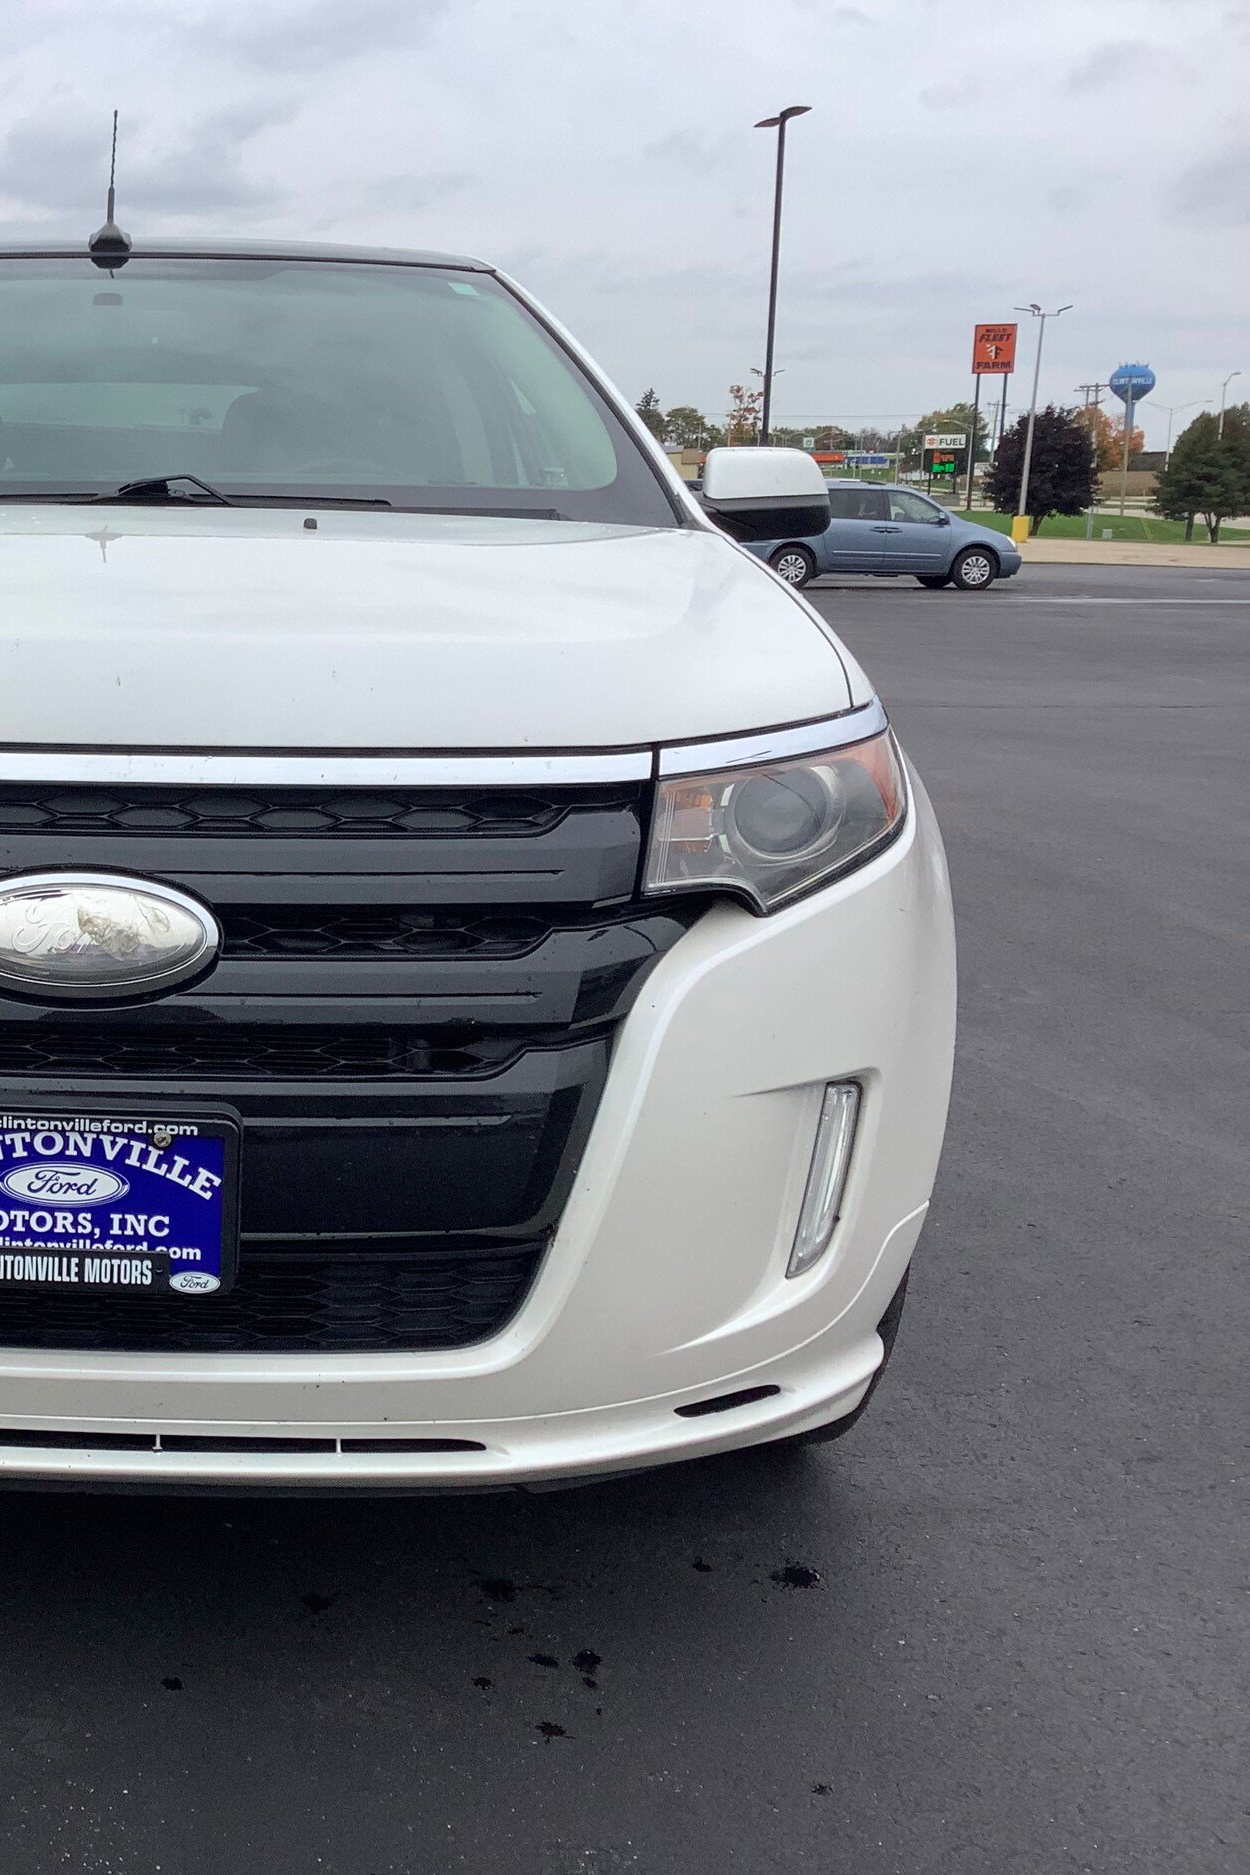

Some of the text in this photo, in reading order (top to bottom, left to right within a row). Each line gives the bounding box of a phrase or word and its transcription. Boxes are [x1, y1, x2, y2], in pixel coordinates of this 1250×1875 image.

[979, 333, 1012, 342] FLEET
[976, 361, 1011, 370] FARM
[939, 438, 964, 446] FUEL
[27, 1169, 98, 1196] Ford
[109, 1213, 170, 1237] INC
[84, 1257, 152, 1286] MOTORS
[180, 1275, 209, 1289] Ford
